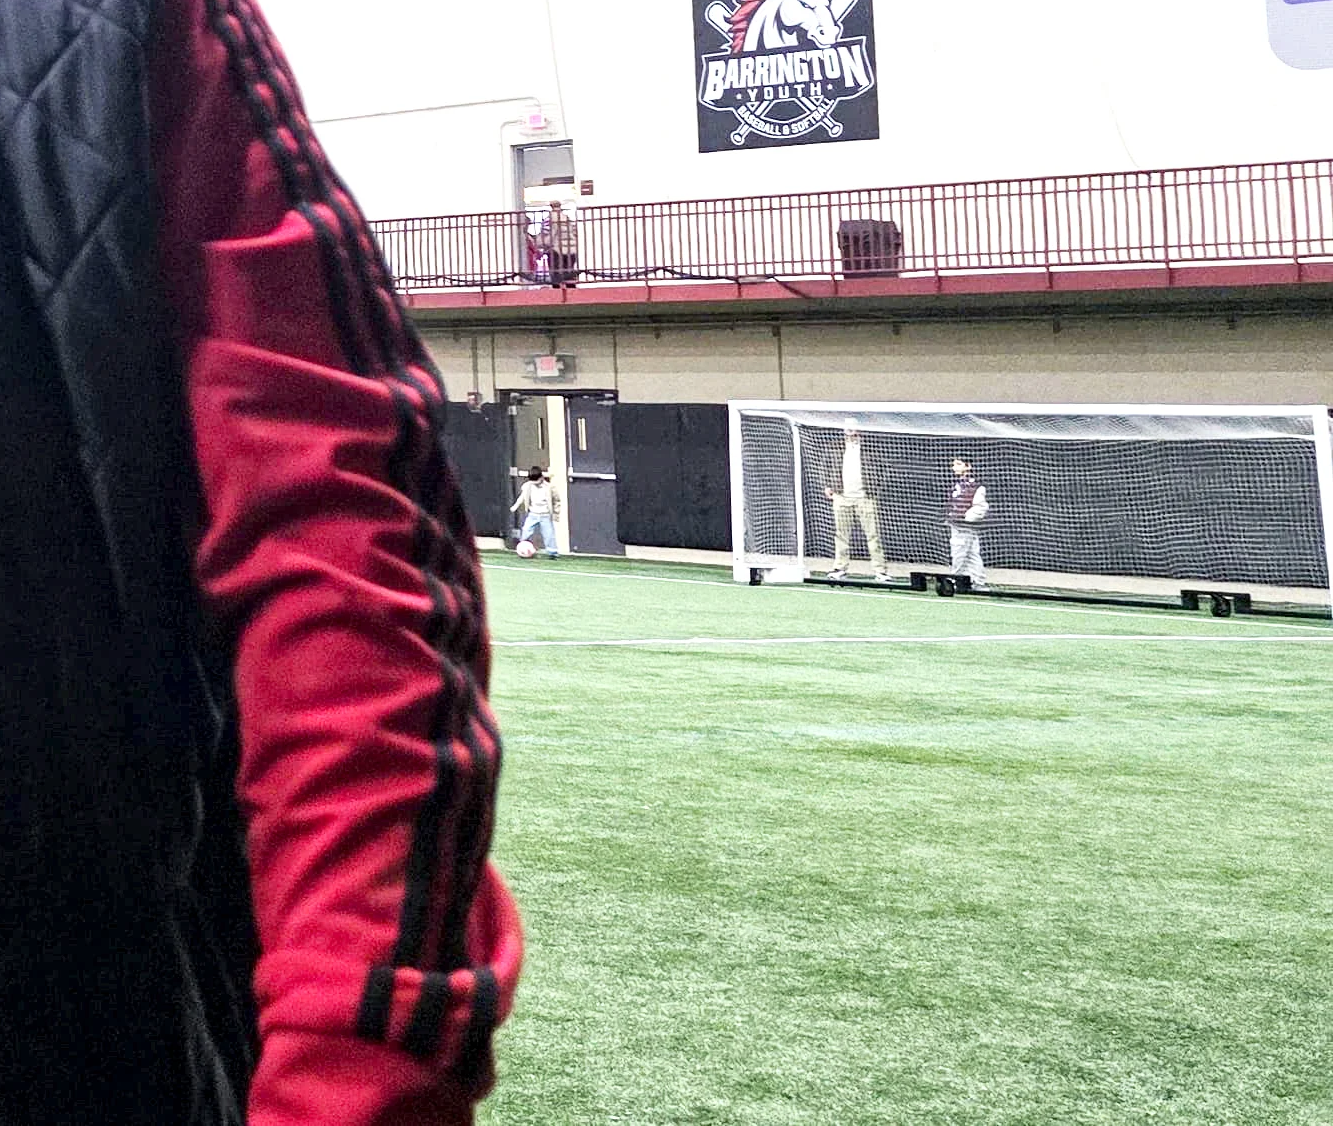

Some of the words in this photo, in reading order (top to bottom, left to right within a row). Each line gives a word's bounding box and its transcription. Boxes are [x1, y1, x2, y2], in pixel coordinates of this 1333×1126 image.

[704, 45, 870, 102] BARRINGTON
[747, 82, 822, 102] YOUTH
[737, 105, 782, 135] BASEBALL
[791, 98, 834, 135] SOFTBALL
